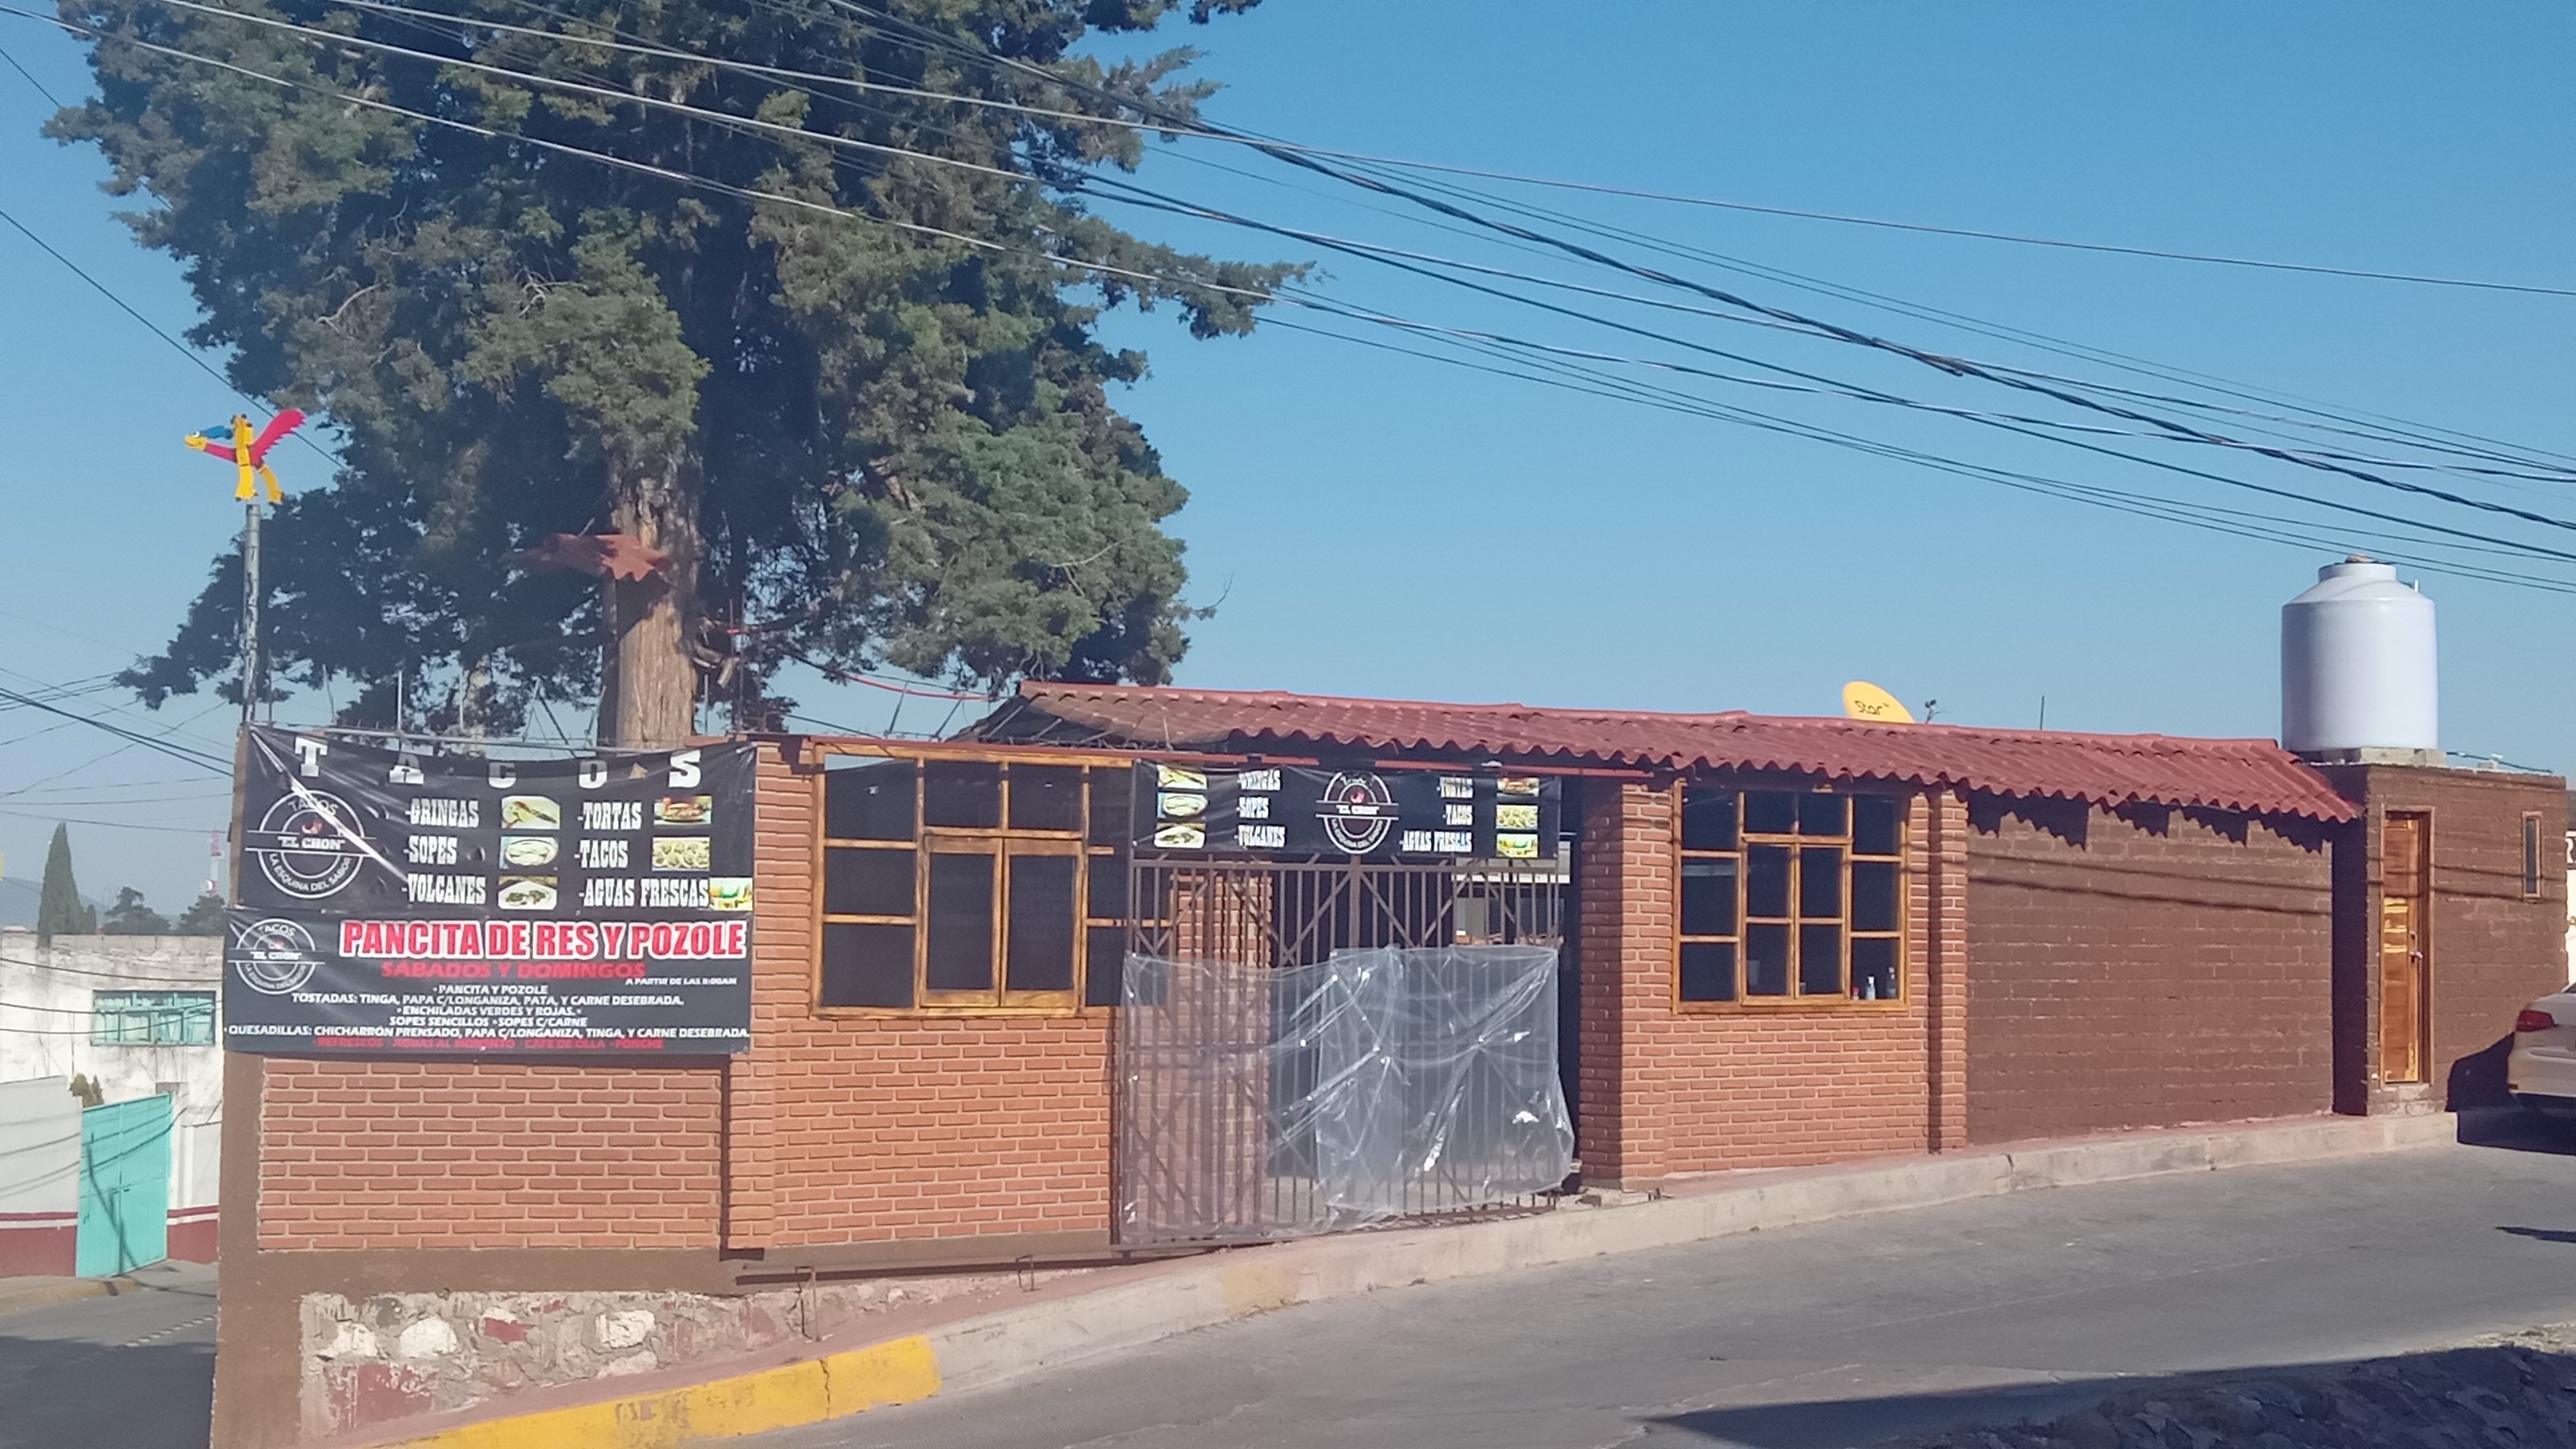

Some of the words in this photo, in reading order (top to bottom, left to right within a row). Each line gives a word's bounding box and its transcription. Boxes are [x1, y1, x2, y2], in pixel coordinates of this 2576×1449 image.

[269, 853, 278, 866] LA
[274, 866, 309, 891] ESQUINA
[311, 882, 330, 891] DEL
[328, 857, 352, 885] SABOR
[640, 879, 709, 907] FRESCAS
[258, 924, 296, 937] TACOS
[340, 919, 483, 958] PANCITA
[486, 921, 530, 959] DE
[533, 921, 598, 960] RES
[600, 923, 626, 959] Y
[627, 921, 747, 959] POZOLE
[498, 962, 511, 978] Y
[517, 962, 647, 979] DOMINGOS
[439, 985, 489, 994] PANCITA
[491, 985, 500, 994] Y
[502, 985, 548, 994] POZOLE
[292, 993, 357, 1003] TOSTADAS:
[402, 996, 434, 1004] PAPA
[560, 996, 569, 1005] Y
[570, 996, 610, 1005] CARNE
[402, 1006, 477, 1015] ENCHILADAS
[480, 1007, 523, 1016] VERDES
[526, 1007, 534, 1016] Y
[389, 1016, 425, 1026] SOPES
[428, 1016, 489, 1026] SENCILLOS
[498, 1017, 533, 1026] SOPES
[536, 1018, 588, 1028] C/CARNE
[228, 1025, 313, 1036] QUESADILLAS:
[465, 1028, 496, 1038] PAPA
[627, 1028, 635, 1038] Y
[636, 1028, 677, 1038] CARNE
